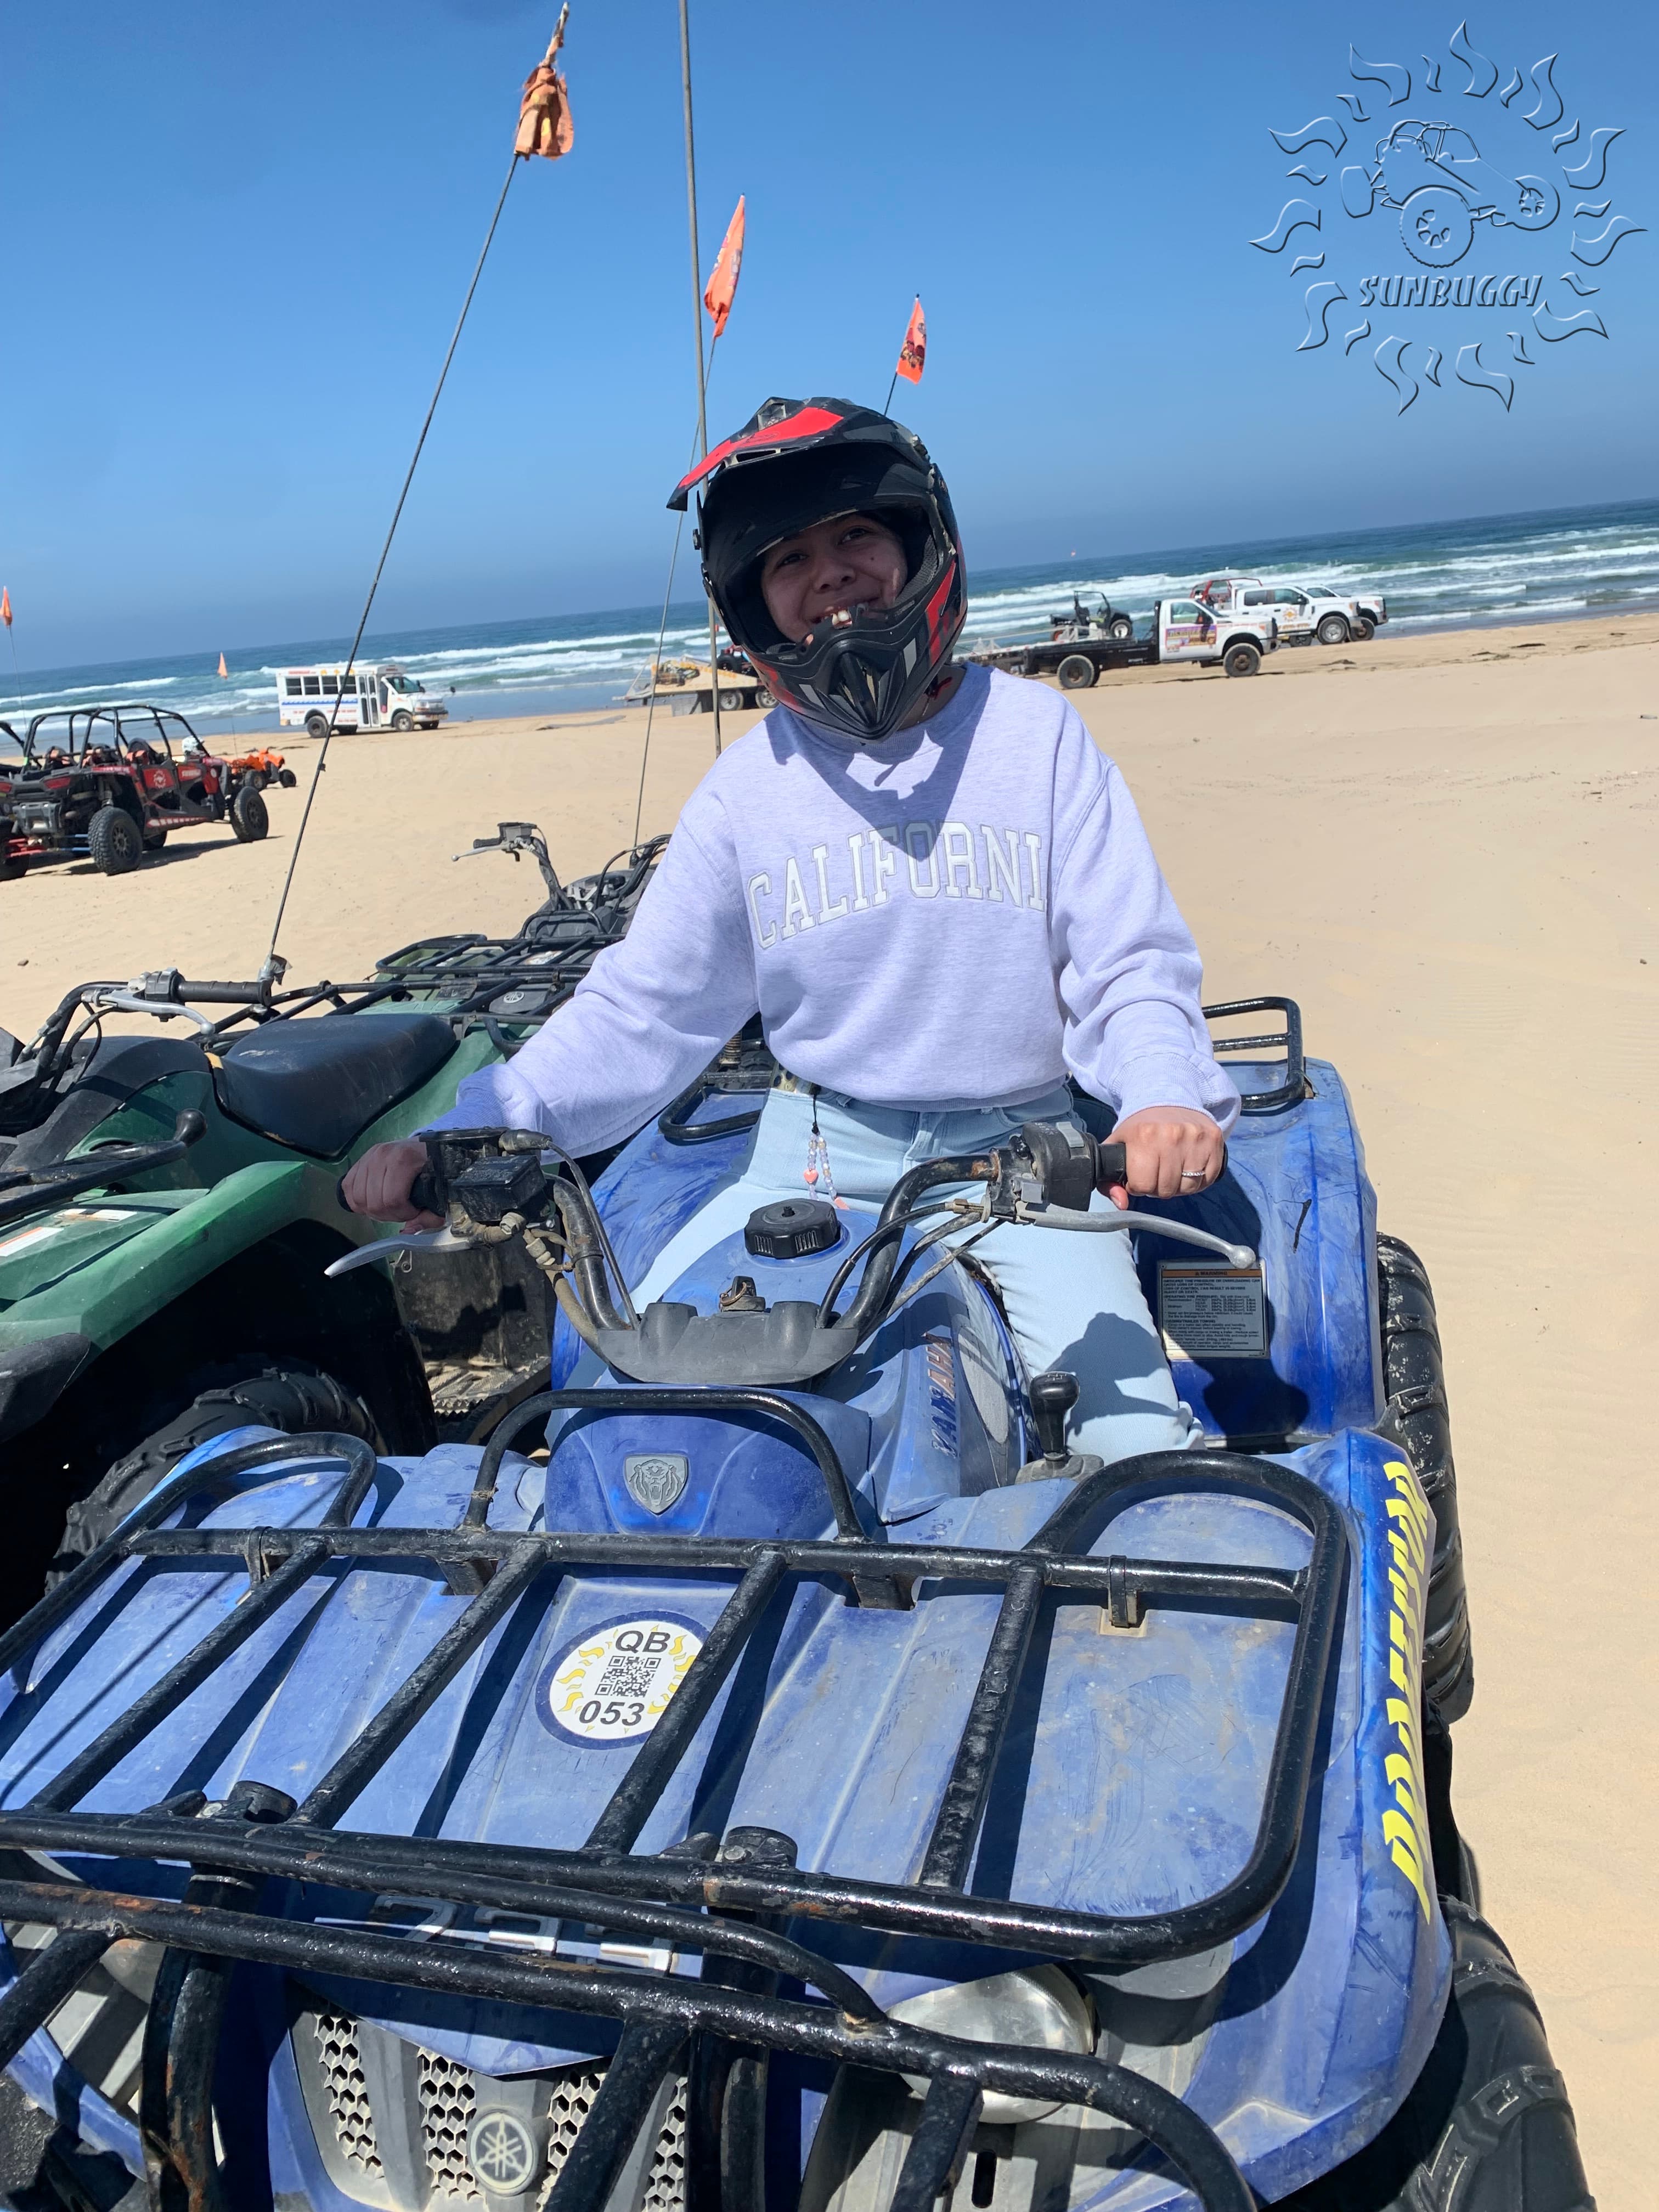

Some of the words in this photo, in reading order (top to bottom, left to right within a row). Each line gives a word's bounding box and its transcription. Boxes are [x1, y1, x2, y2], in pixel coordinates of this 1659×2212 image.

[921, 1331, 958, 1459] YAMAHA
[615, 1630, 671, 1654] QB
[579, 1700, 645, 1726] 053
